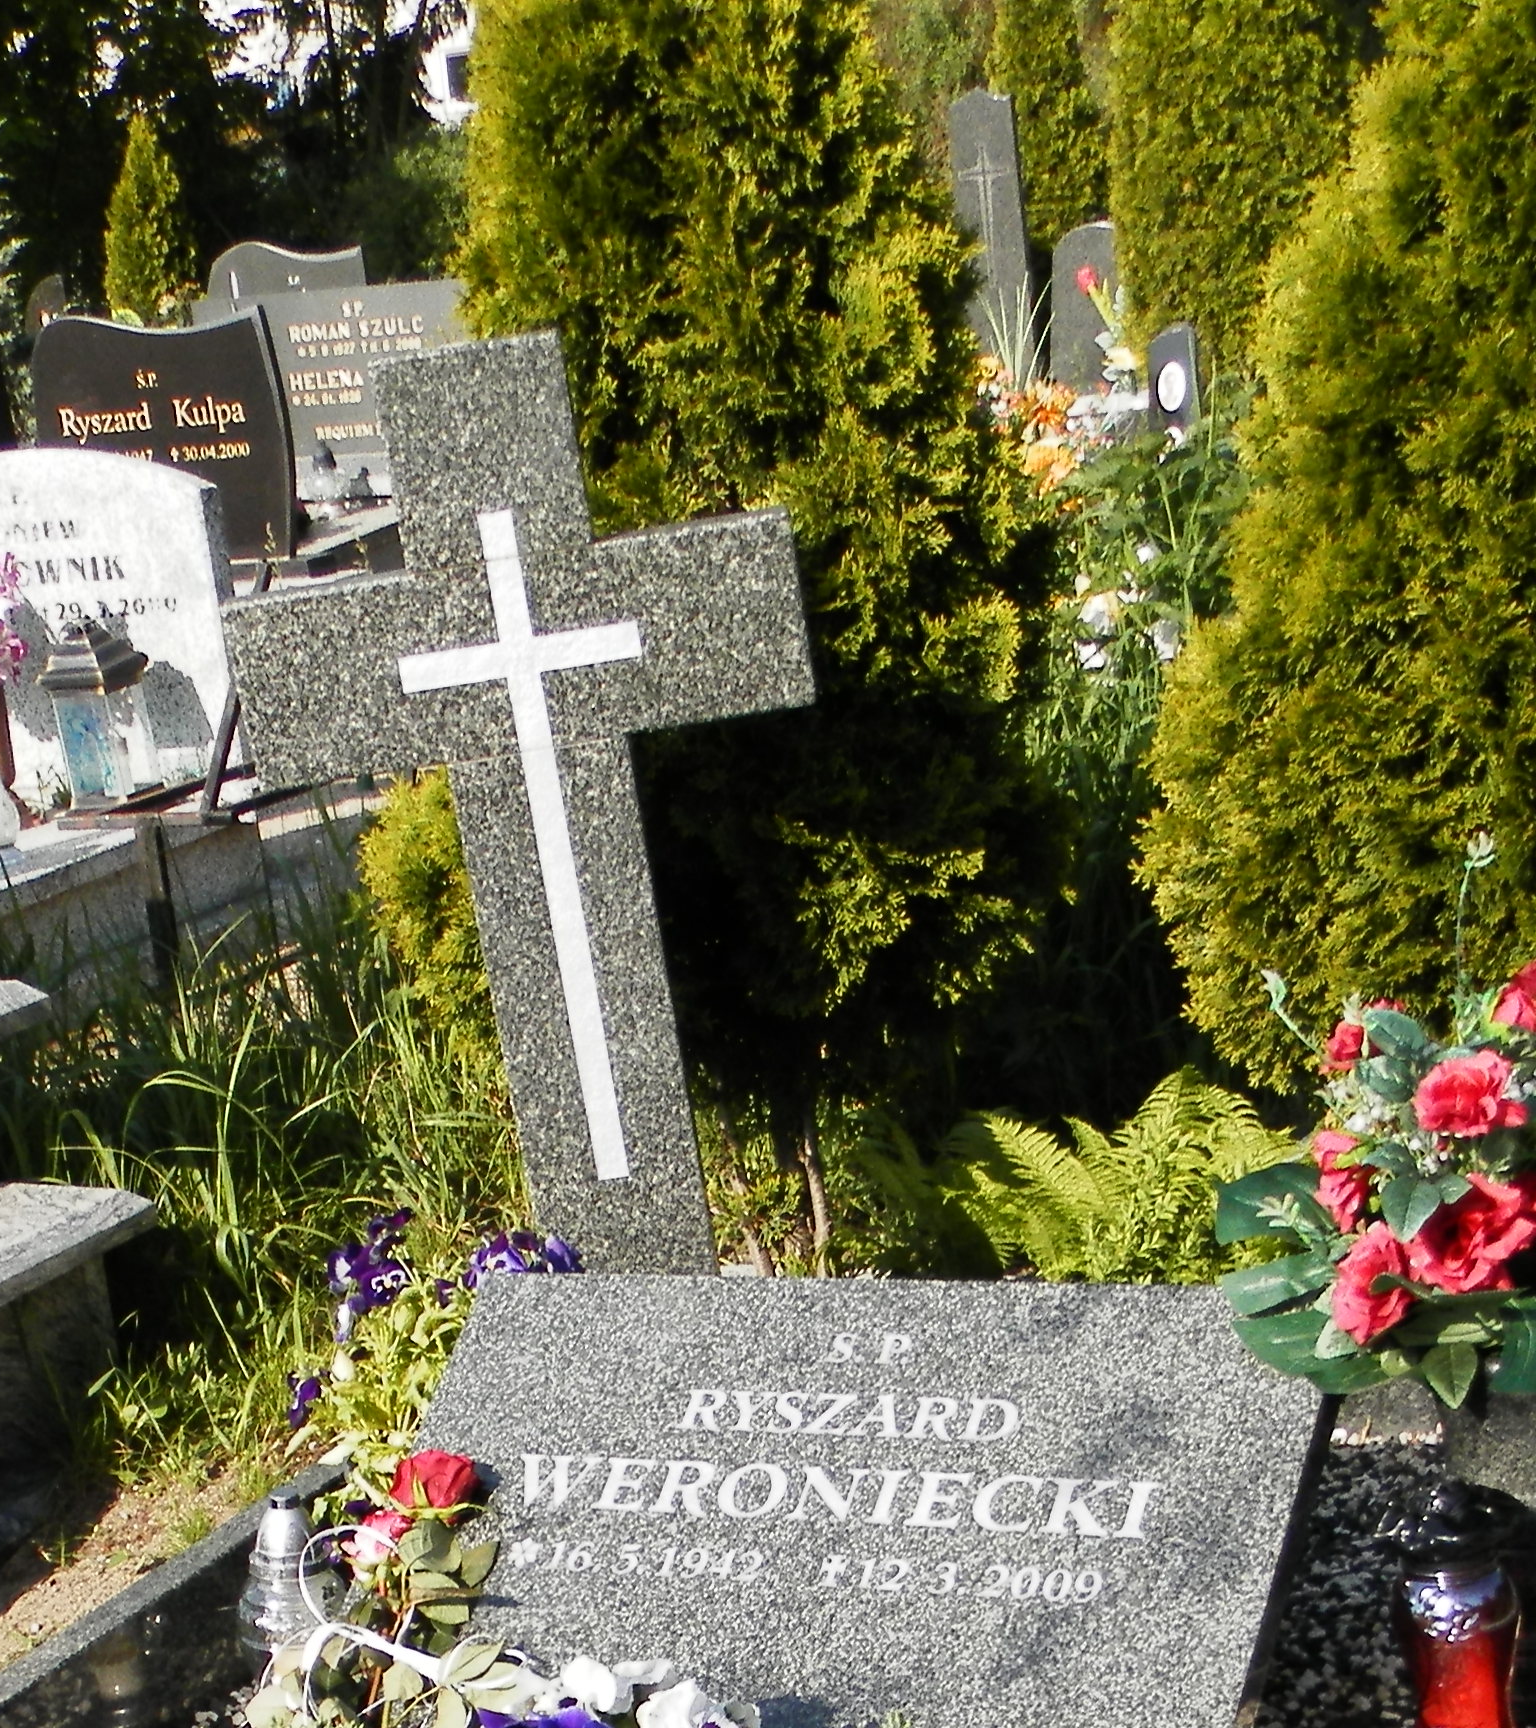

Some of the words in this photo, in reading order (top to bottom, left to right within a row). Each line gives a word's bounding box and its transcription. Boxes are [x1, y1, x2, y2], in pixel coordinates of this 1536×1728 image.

[289, 321, 351, 344] ROMAN
[358, 314, 424, 339] SZULC
[289, 368, 364, 392] HELENA
[58, 401, 153, 445] Ryszard
[172, 396, 246, 434] Kulpa
[183, 442, 251, 462] 30.04.2000
[676, 1387, 1020, 1443] RYSZARD
[520, 1452, 1164, 1540] WERONIECKI
